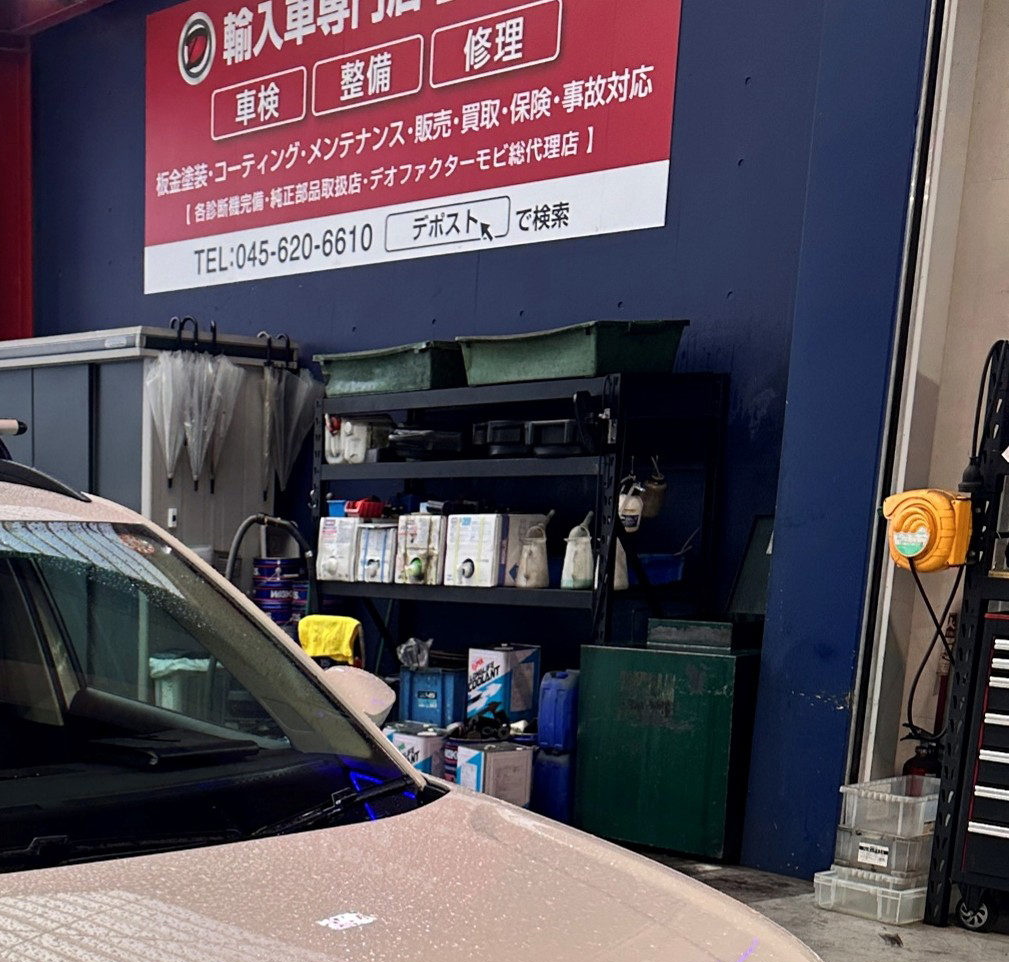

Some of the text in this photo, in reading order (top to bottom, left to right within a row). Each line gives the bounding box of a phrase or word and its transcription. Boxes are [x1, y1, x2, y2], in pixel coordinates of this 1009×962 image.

[235, 17, 524, 126] 車検 整備 修理
[194, 202, 570, 275] TEL:045-620-6610 デポスト で検索
